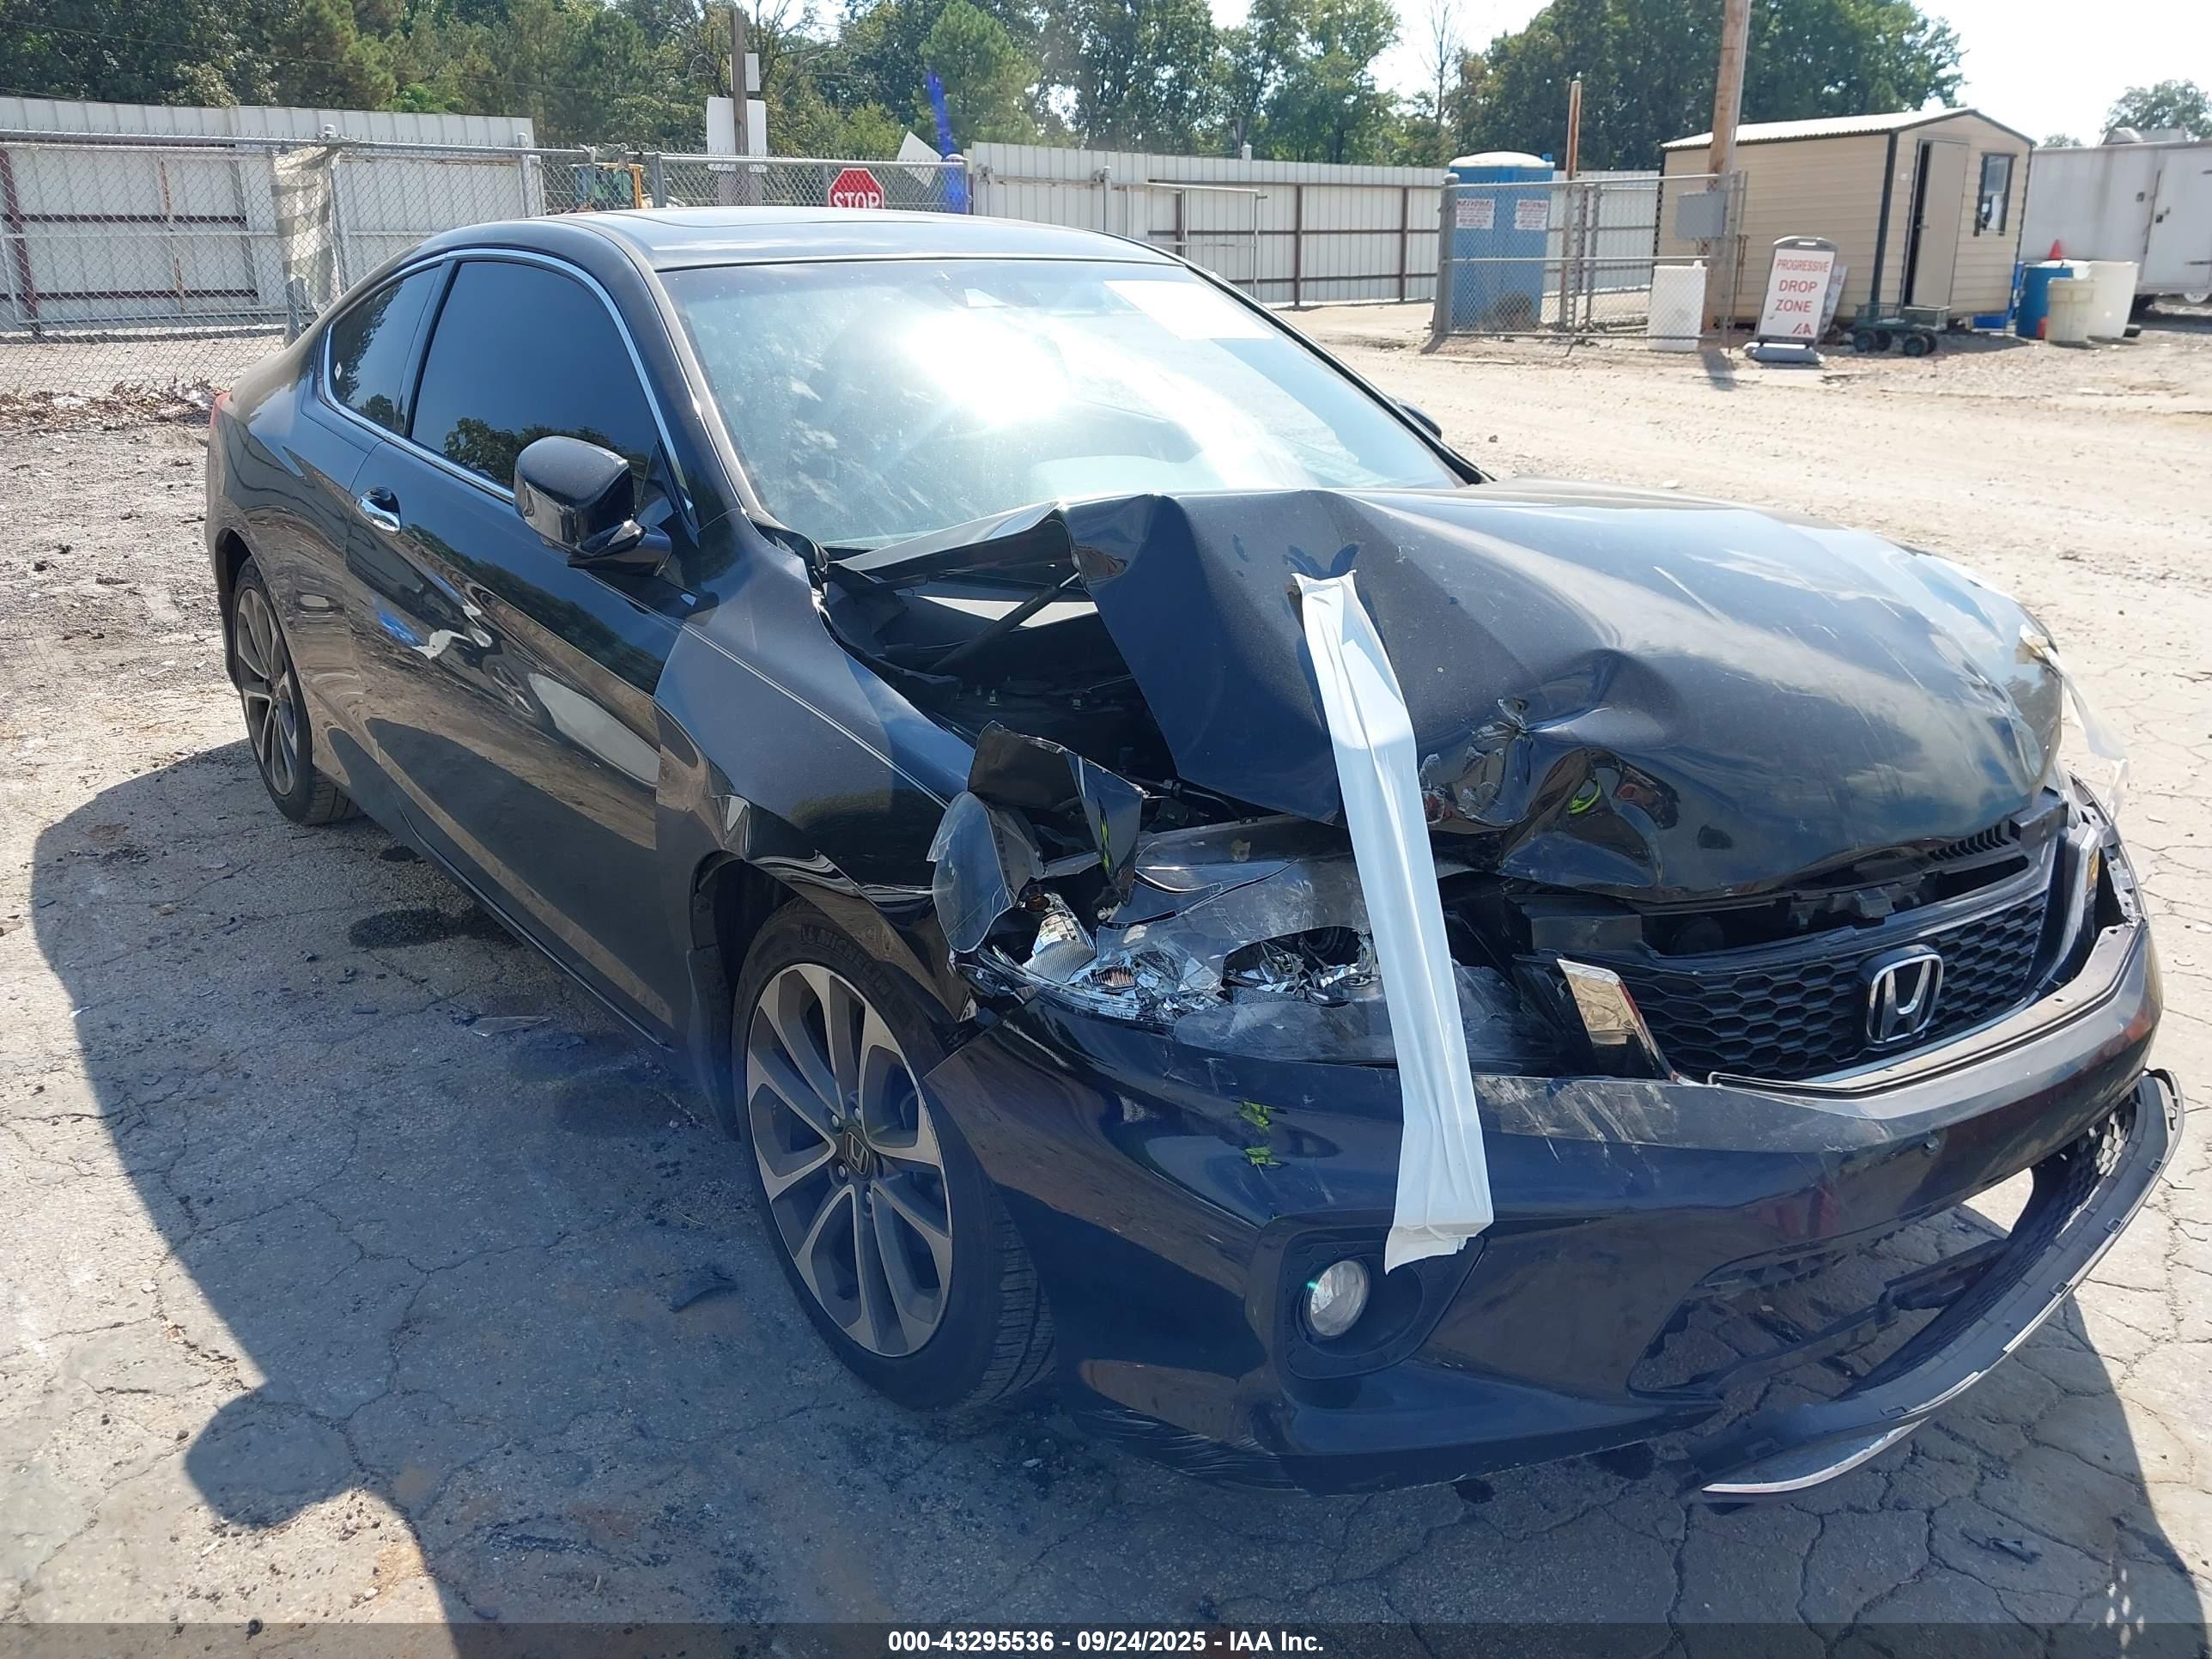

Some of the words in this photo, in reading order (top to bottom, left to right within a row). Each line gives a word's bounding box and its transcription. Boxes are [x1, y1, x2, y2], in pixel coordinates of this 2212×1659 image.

[834, 191, 880, 208] STOP
[1777, 259, 1829, 273] PROGRESSIVE
[1778, 279, 1818, 293] DROP
[1775, 299, 1813, 313] ZONE
